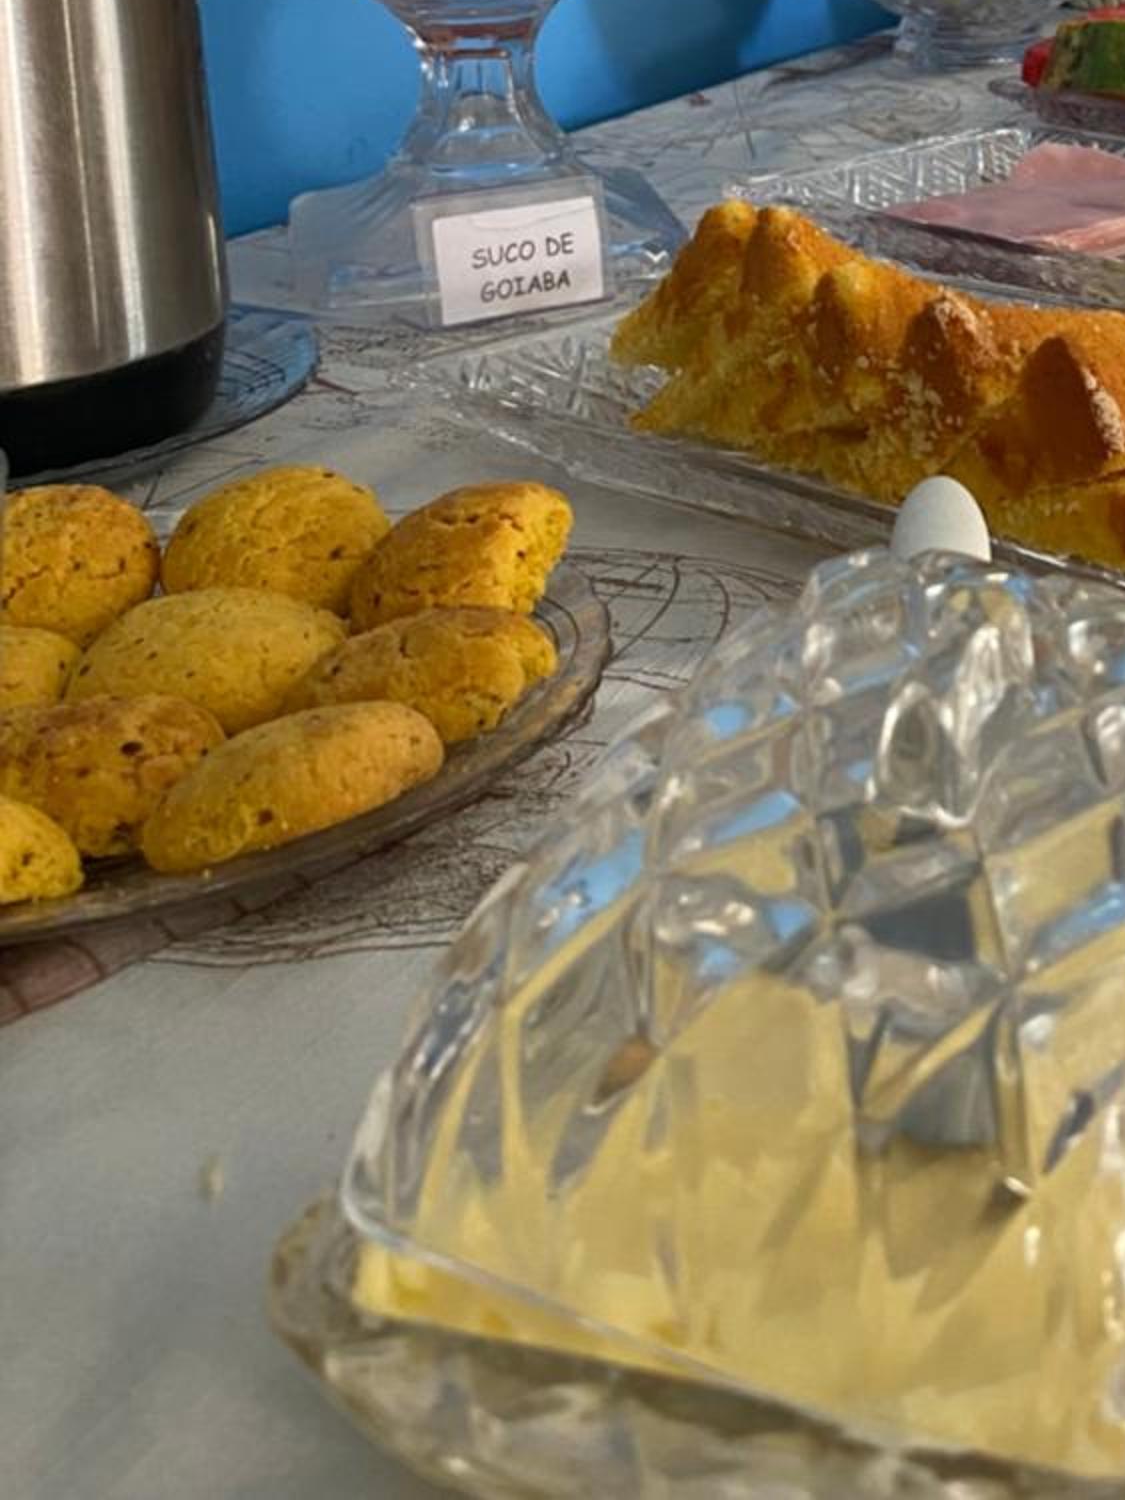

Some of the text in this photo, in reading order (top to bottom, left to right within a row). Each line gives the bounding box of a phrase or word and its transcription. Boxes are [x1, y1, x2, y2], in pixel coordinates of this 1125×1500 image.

[472, 232, 574, 269] SUCO DE
[480, 270, 571, 303] GOIABA
